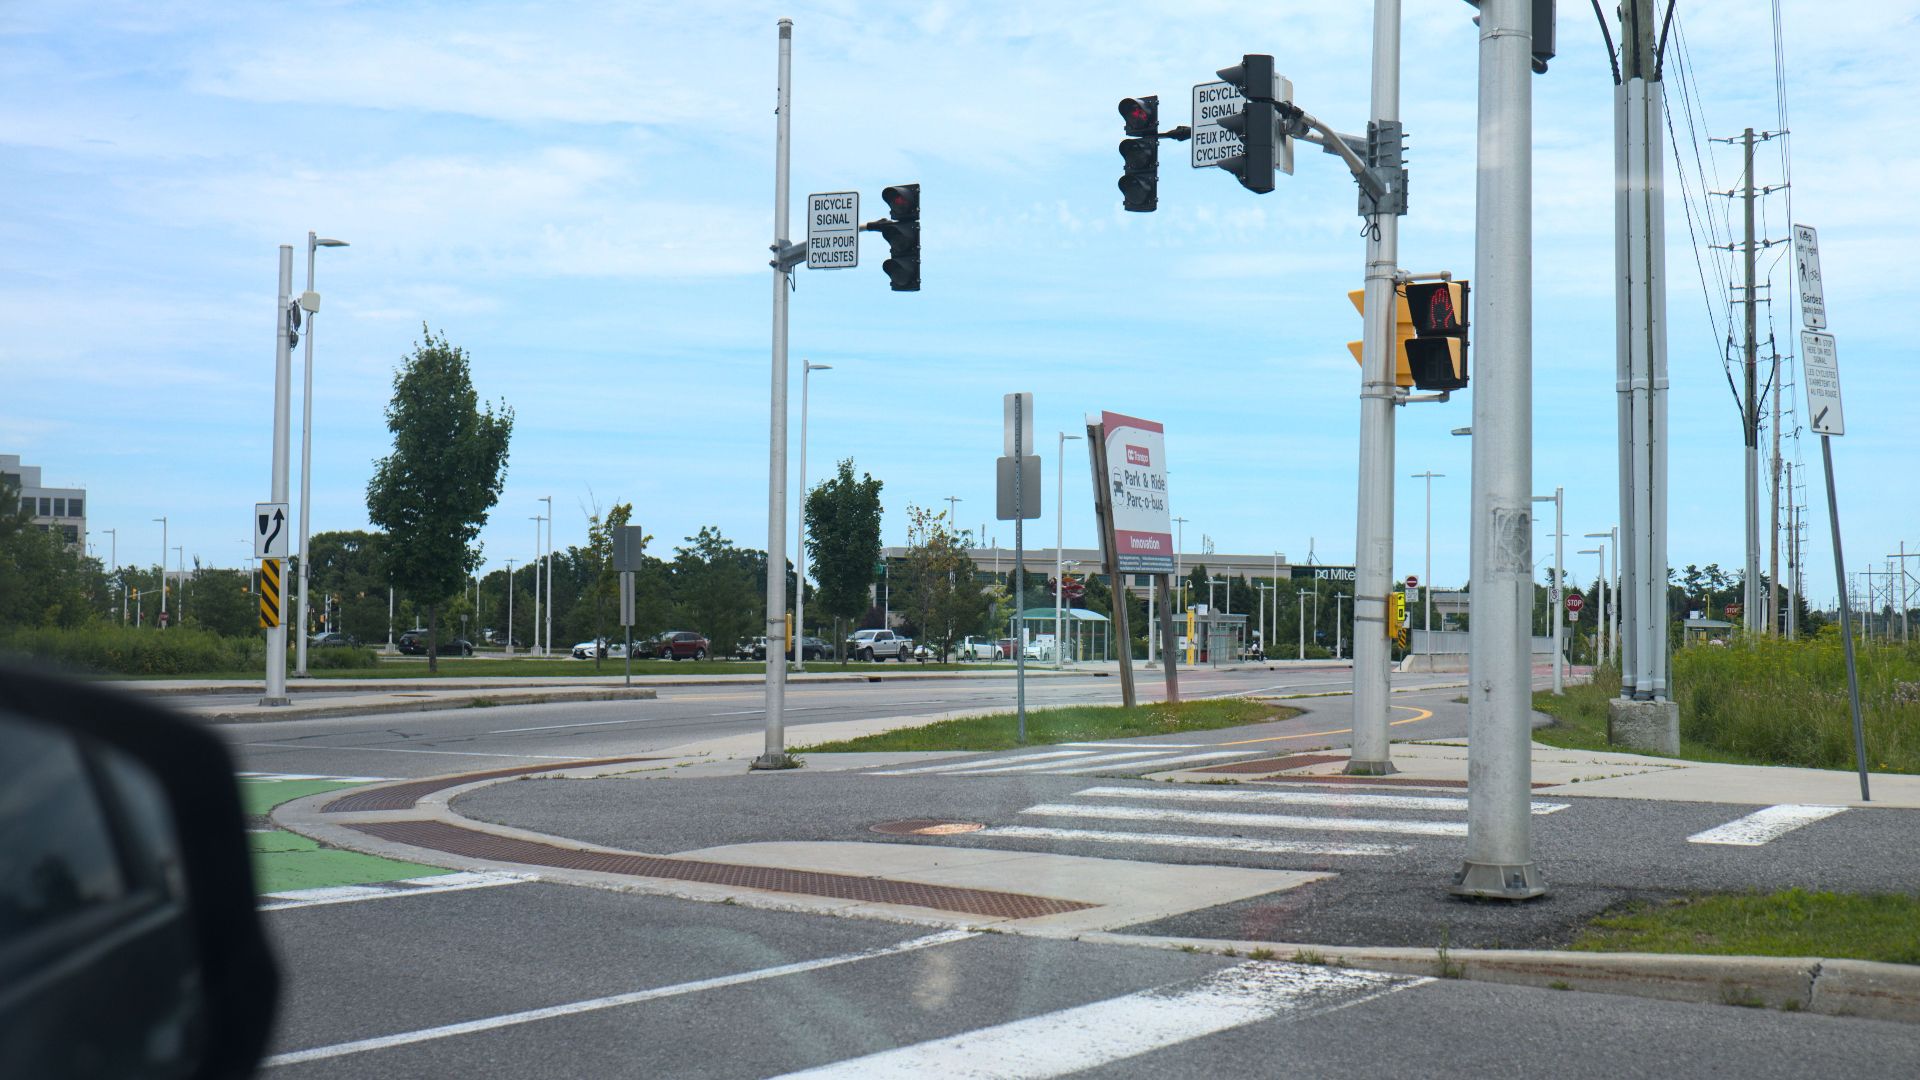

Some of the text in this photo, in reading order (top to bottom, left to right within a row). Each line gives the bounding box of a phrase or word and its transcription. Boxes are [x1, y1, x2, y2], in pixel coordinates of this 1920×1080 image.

[1200, 86, 1240, 103] BICYCLE
[1202, 103, 1238, 119] SIGNAL
[1196, 132, 1218, 145] FEUX
[1196, 144, 1242, 162] CYCLISTES
[814, 198, 852, 210] BICYCLE
[816, 213, 850, 226] SIGNAL
[812, 236, 854, 248] FEUX POUR
[812, 250, 854, 264] CYCLISTES
[1802, 292, 1822, 305] Gardez
[1124, 470, 1165, 490] Park & Ride
[1126, 492, 1164, 511] Parc-o-bus
[1130, 536, 1160, 550] Innovation
[1330, 568, 1356, 580] Mite
